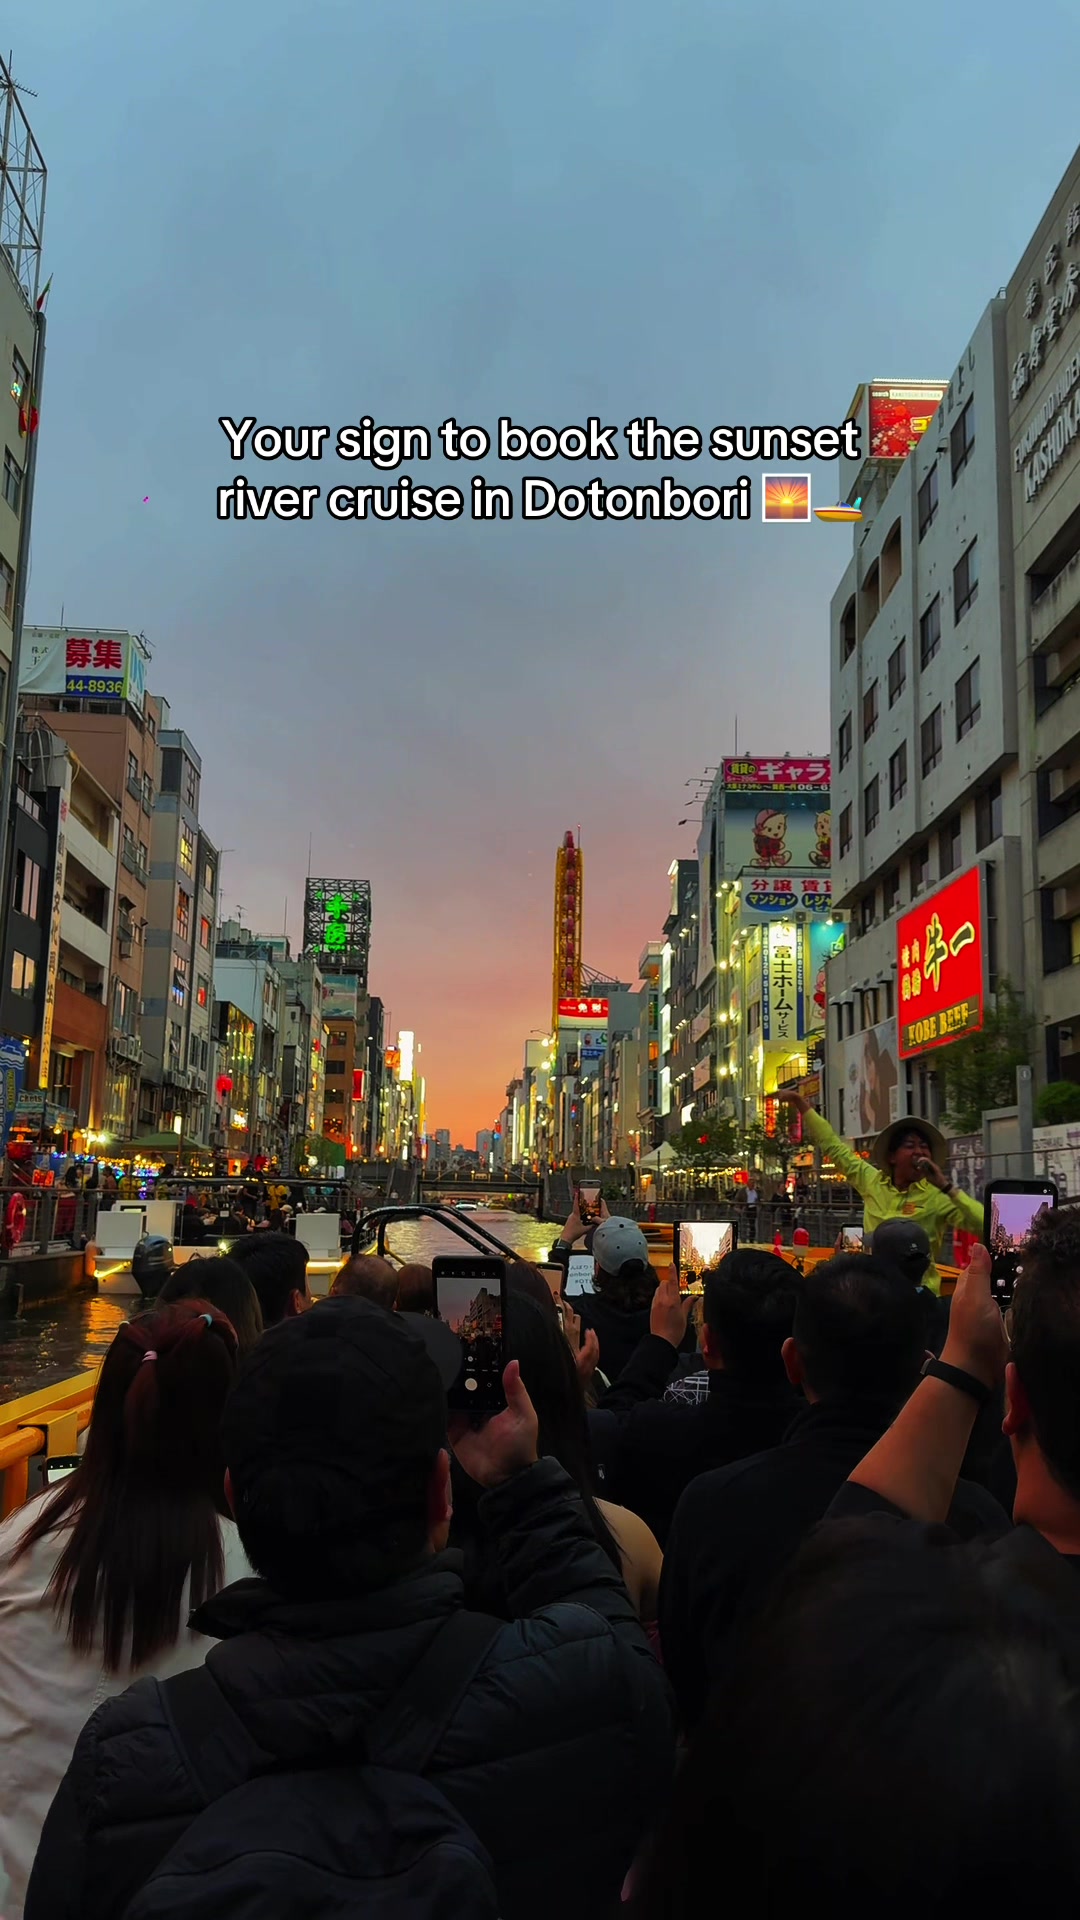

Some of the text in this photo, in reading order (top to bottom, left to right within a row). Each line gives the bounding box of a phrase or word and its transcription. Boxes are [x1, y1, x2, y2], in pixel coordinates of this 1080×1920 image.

[65, 637, 123, 670] 募集
[66, 679, 123, 694] 44-8936
[758, 761, 832, 781] ギャラ
[797, 783, 832, 791] 06-6
[749, 894, 796, 906] マンション
[907, 1002, 969, 1047] KOBE BEEF
